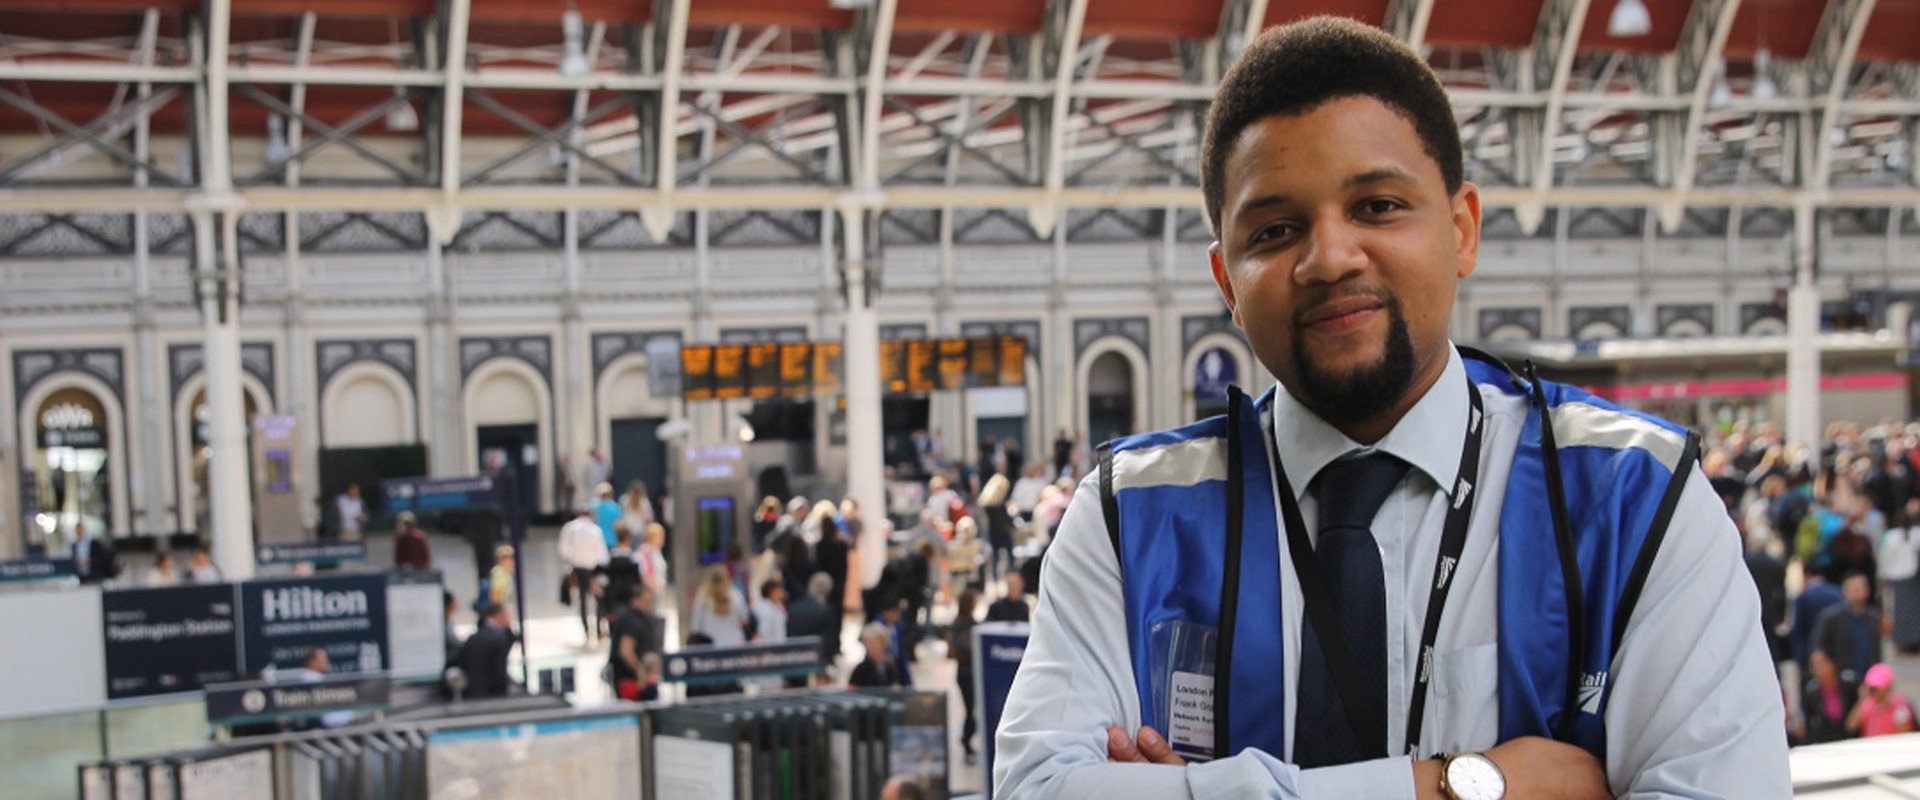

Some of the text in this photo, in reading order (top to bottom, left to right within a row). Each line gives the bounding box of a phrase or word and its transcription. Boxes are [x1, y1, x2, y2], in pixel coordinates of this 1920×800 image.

[263, 586, 368, 620] Hilton
[273, 687, 357, 706] Train times
[1176, 684, 1207, 696] London
